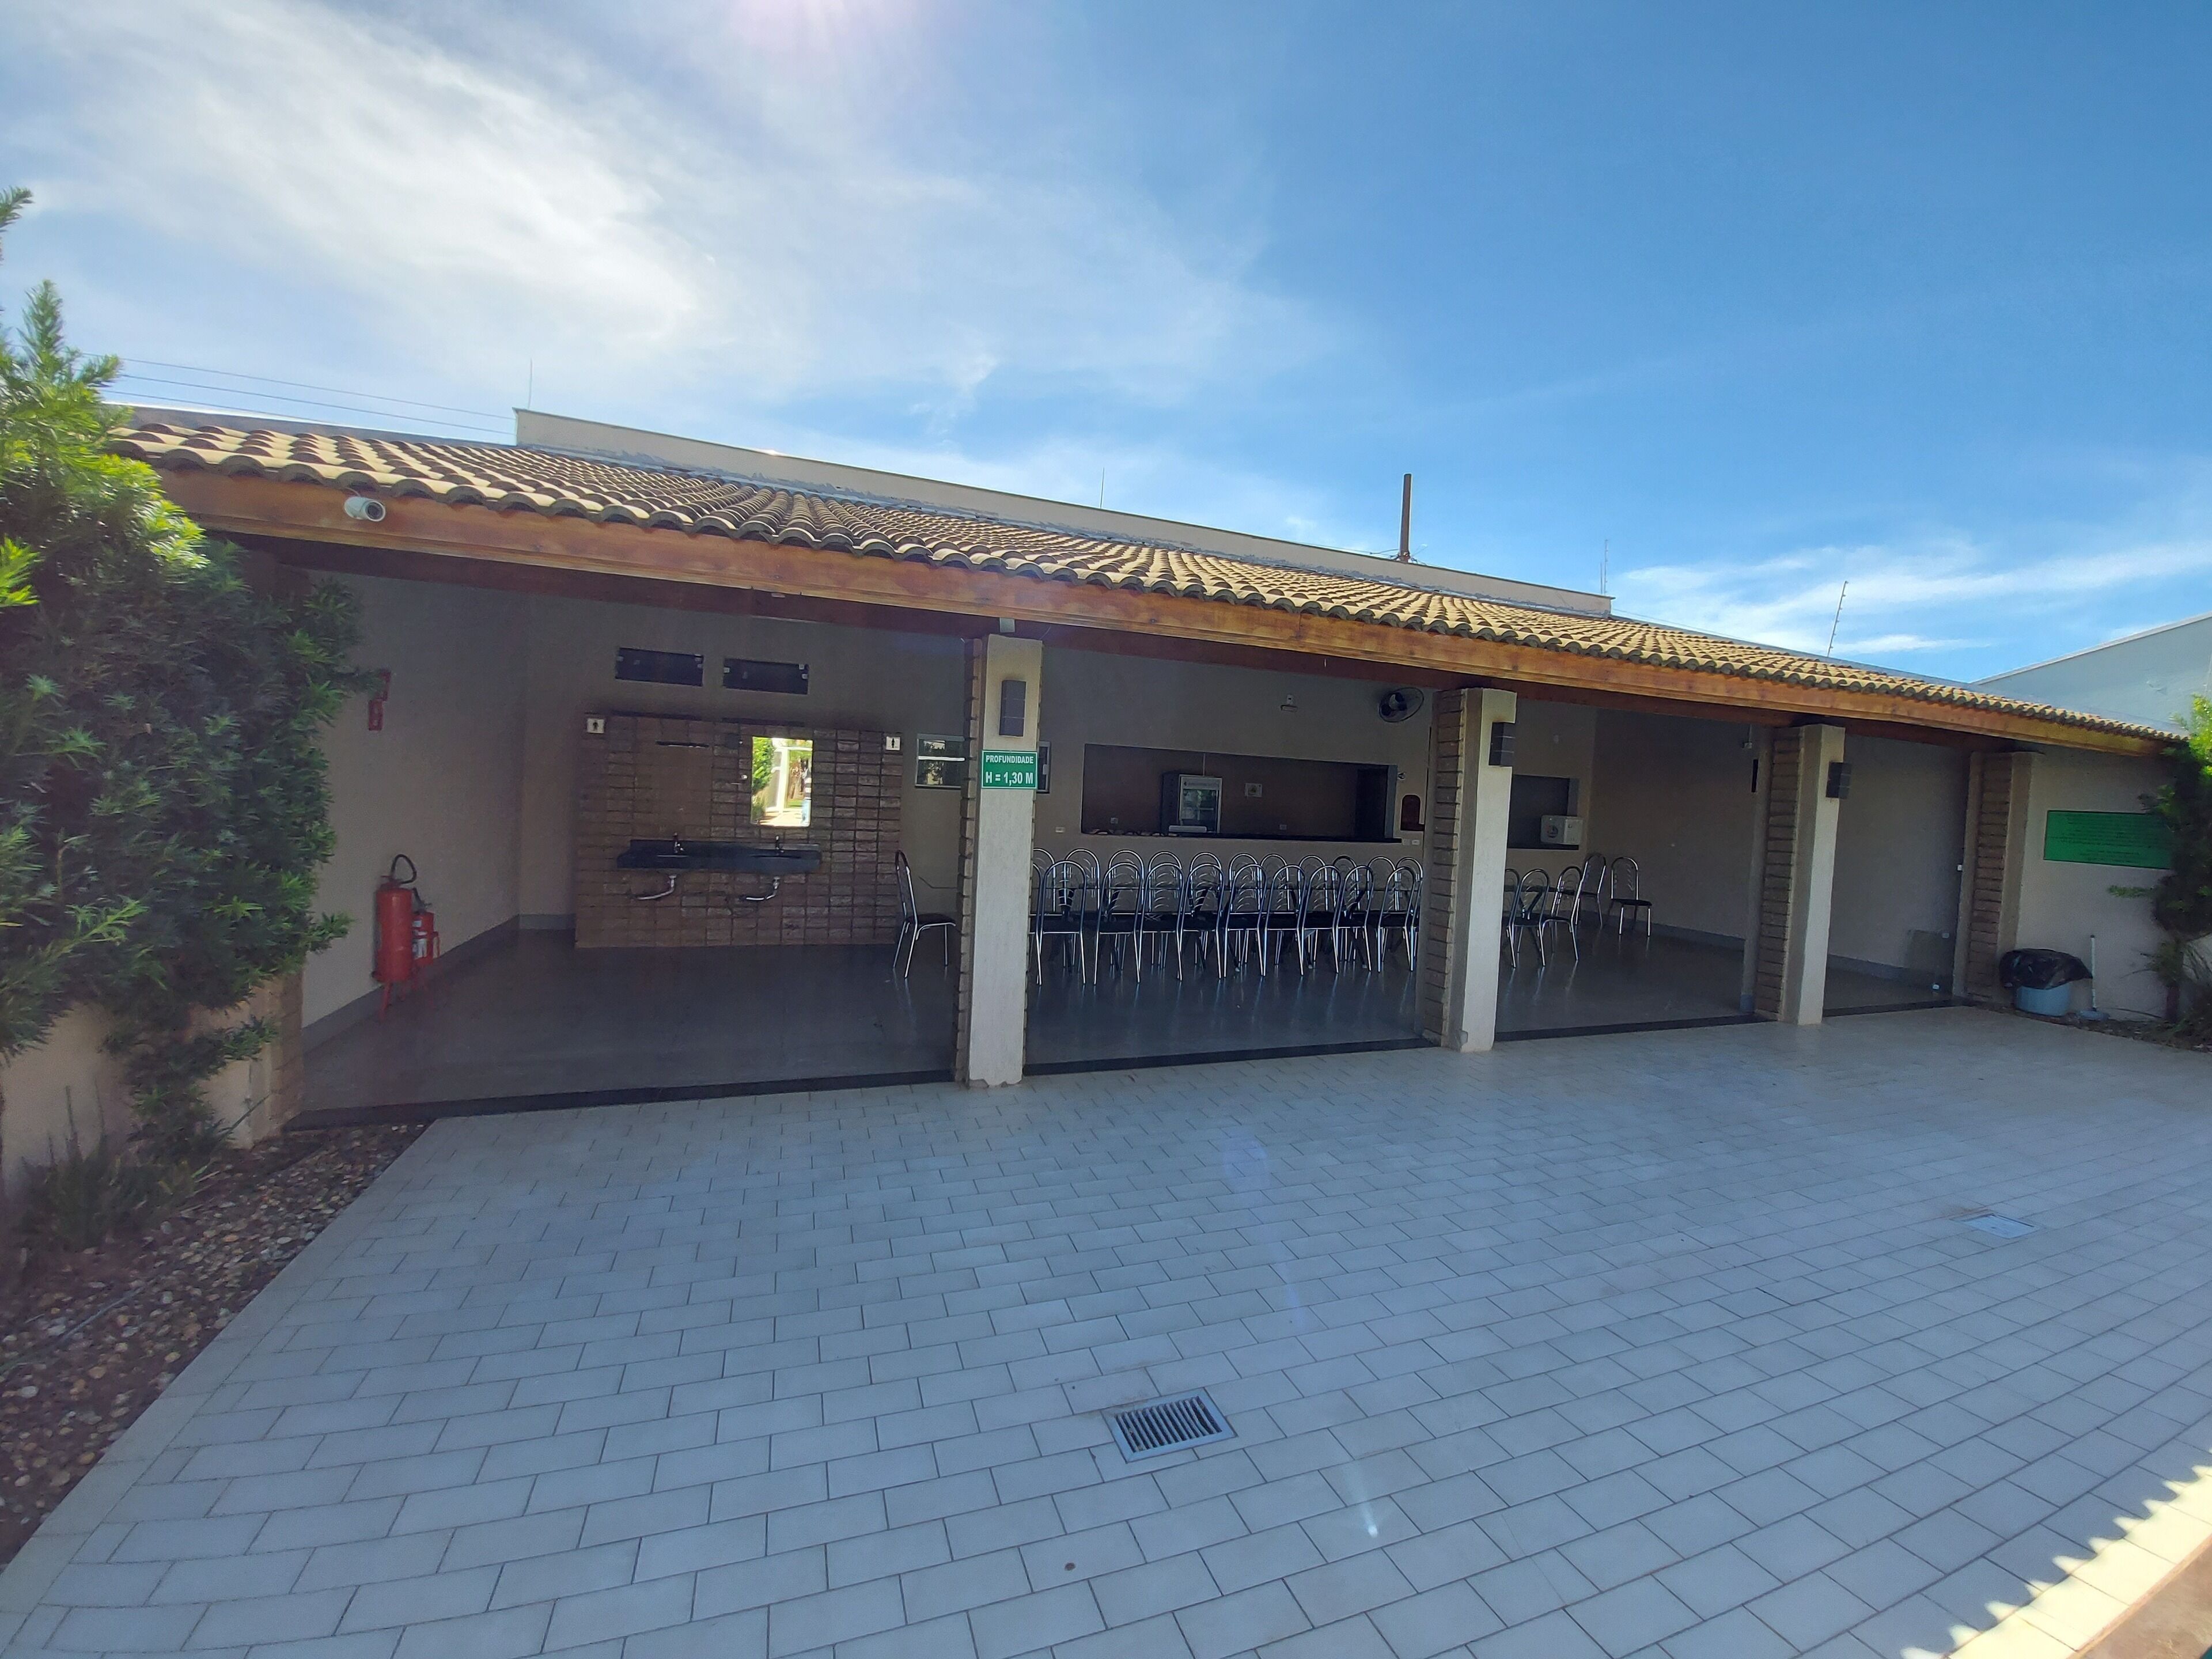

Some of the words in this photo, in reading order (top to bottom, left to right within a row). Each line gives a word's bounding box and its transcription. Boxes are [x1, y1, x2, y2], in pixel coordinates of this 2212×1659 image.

[986, 755, 1033, 764] PROFUNDIDADE
[986, 771, 993, 783] H
[1003, 771, 1023, 786] 1,30
[1025, 772, 1033, 784] M
